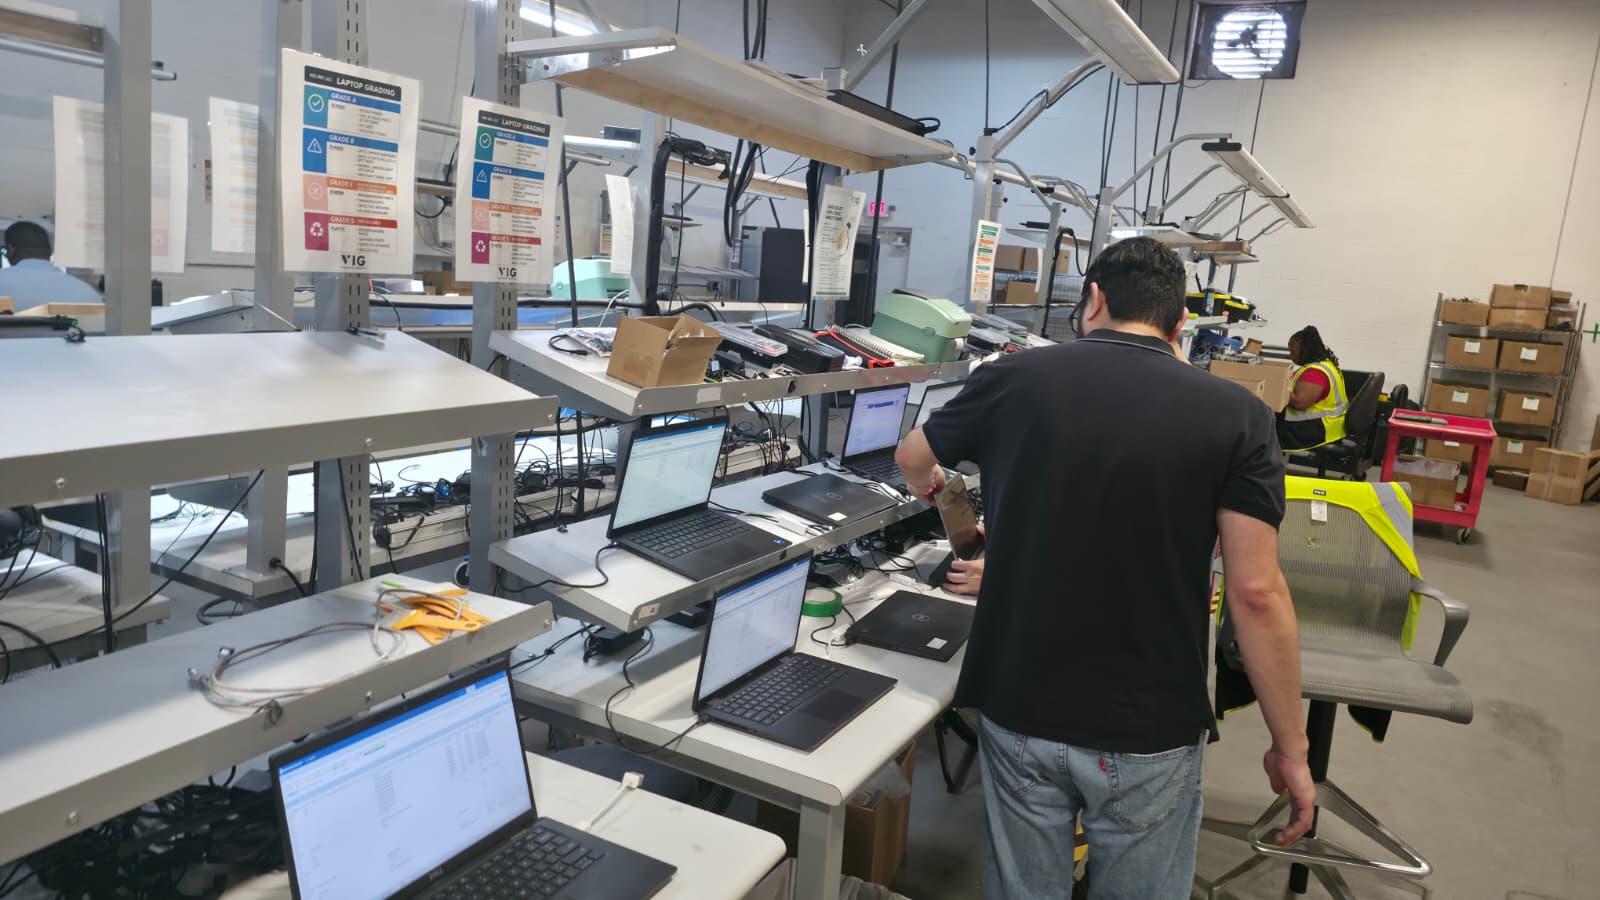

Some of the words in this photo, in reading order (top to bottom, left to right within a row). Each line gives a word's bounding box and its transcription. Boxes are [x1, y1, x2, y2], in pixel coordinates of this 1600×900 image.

[336, 77, 363, 89] LAPTOP
[364, 84, 396, 97] GRADING
[331, 92, 351, 101] GRADE
[501, 119, 521, 128] LAPTOP
[522, 124, 546, 133] GRADING
[329, 134, 350, 143] GRADE
[869, 202, 885, 216] ET
[341, 254, 366, 266] VIG
[498, 267, 517, 278] VIG
